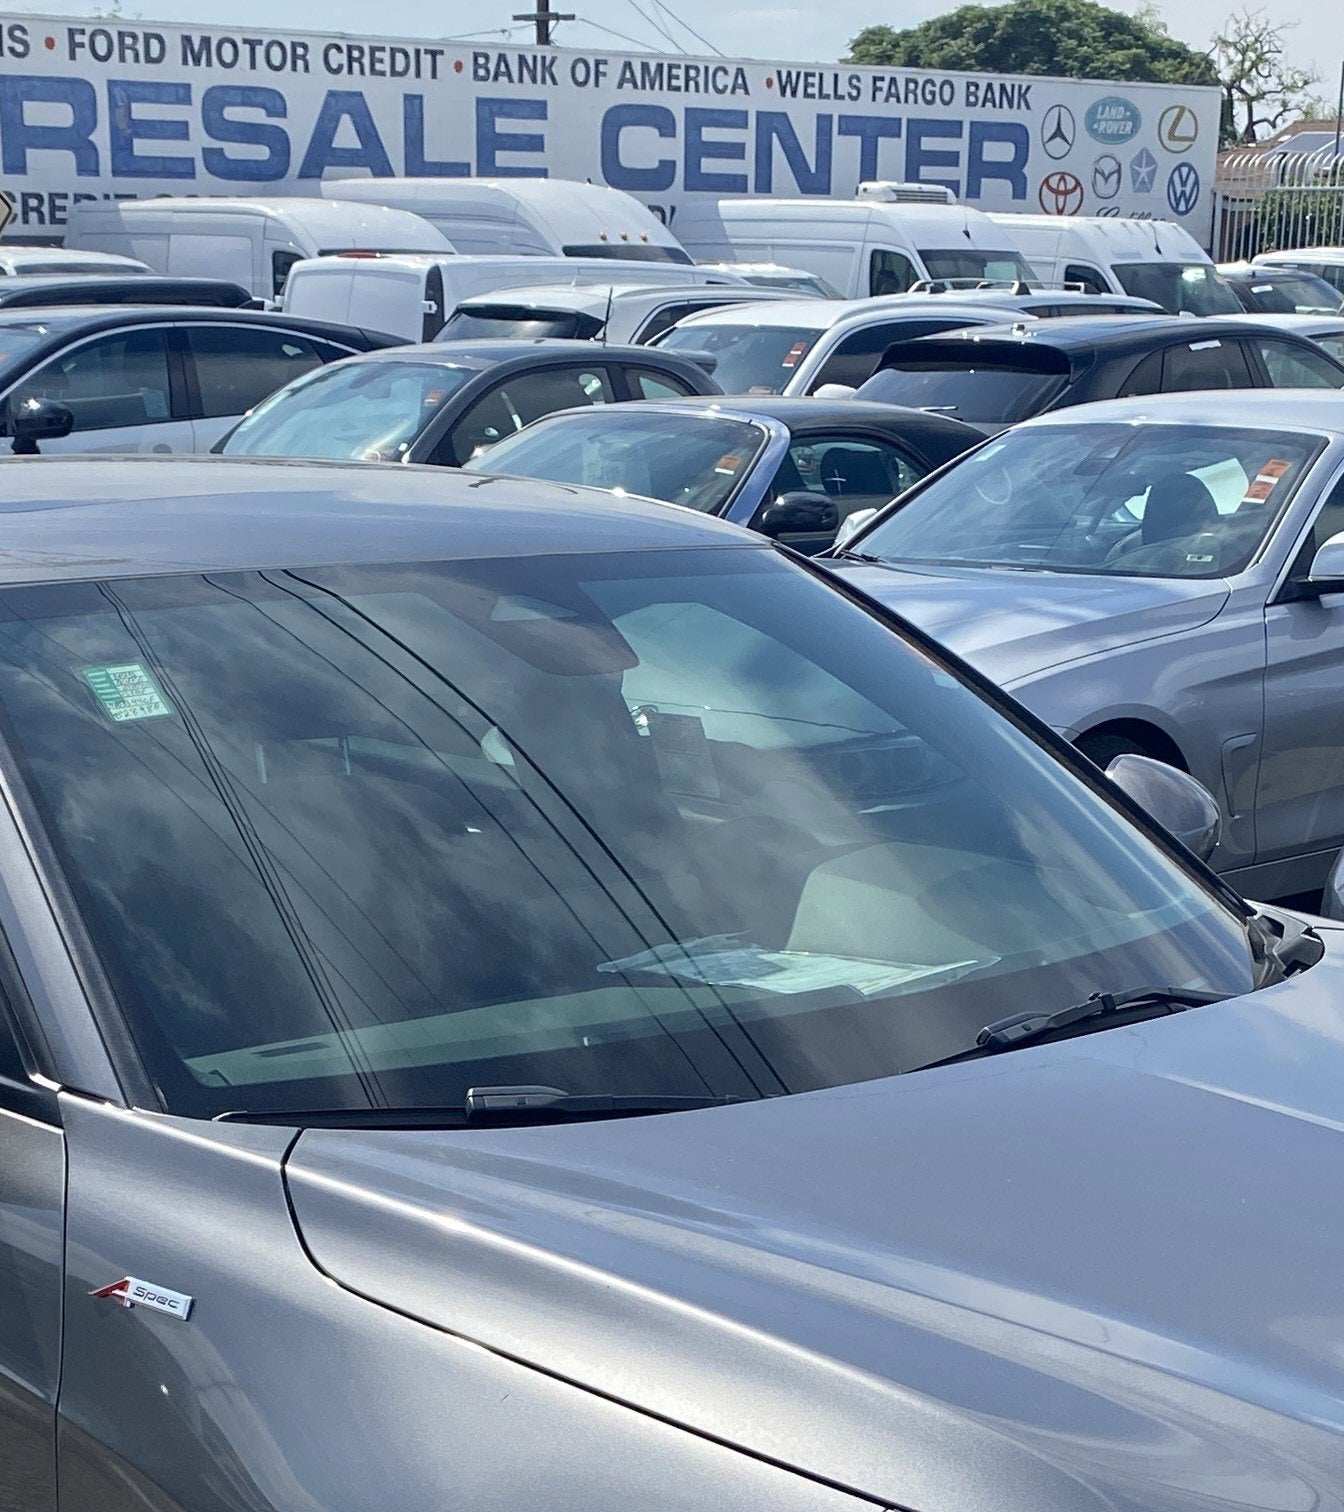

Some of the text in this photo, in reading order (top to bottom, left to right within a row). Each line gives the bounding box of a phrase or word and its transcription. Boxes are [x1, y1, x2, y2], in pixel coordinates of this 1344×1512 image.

[67, 27, 444, 79] FORD MOTOR CREDIT
[472, 51, 750, 96] BANK OF AMERICA
[776, 69, 1032, 111] WELLS FARGO BANK
[601, 103, 1031, 201] CENTER
